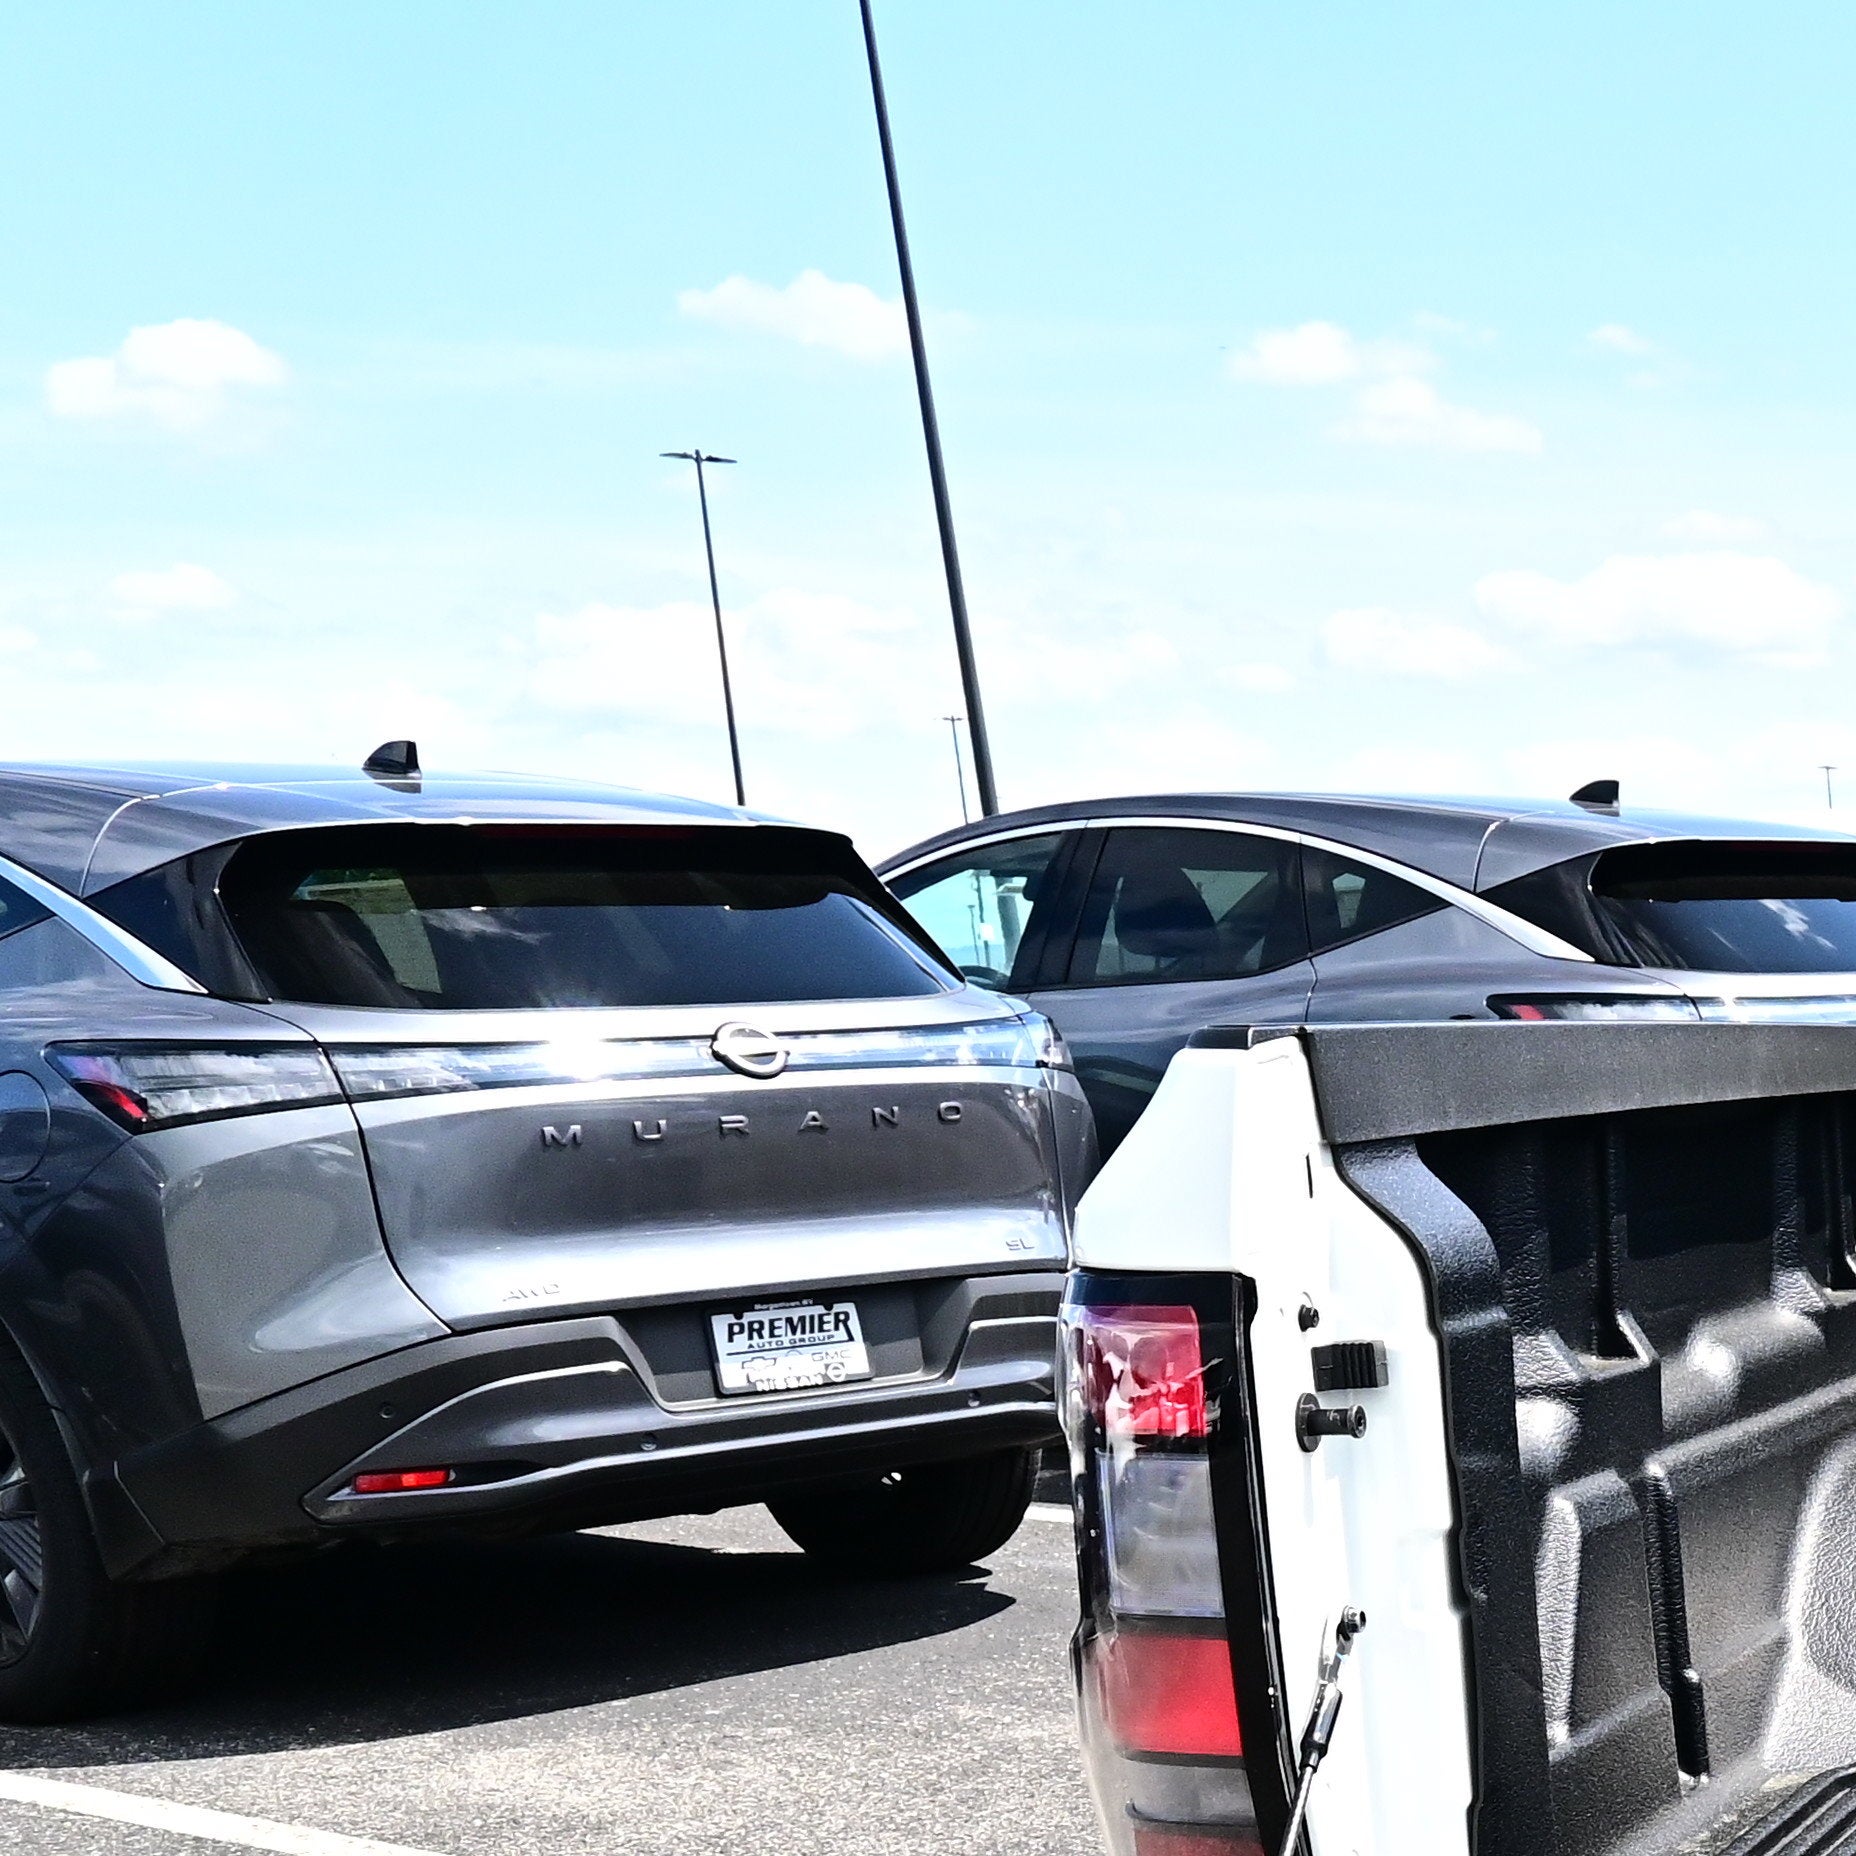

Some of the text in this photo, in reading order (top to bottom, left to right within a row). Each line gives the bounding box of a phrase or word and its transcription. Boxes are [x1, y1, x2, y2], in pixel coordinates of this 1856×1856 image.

[541, 1100, 964, 1148] MURANO
[1005, 1238, 1035, 1251] SL
[727, 1310, 855, 1344] PREMIER
[747, 1334, 835, 1350] AUTO GROUP
[811, 1350, 851, 1362] GMC
